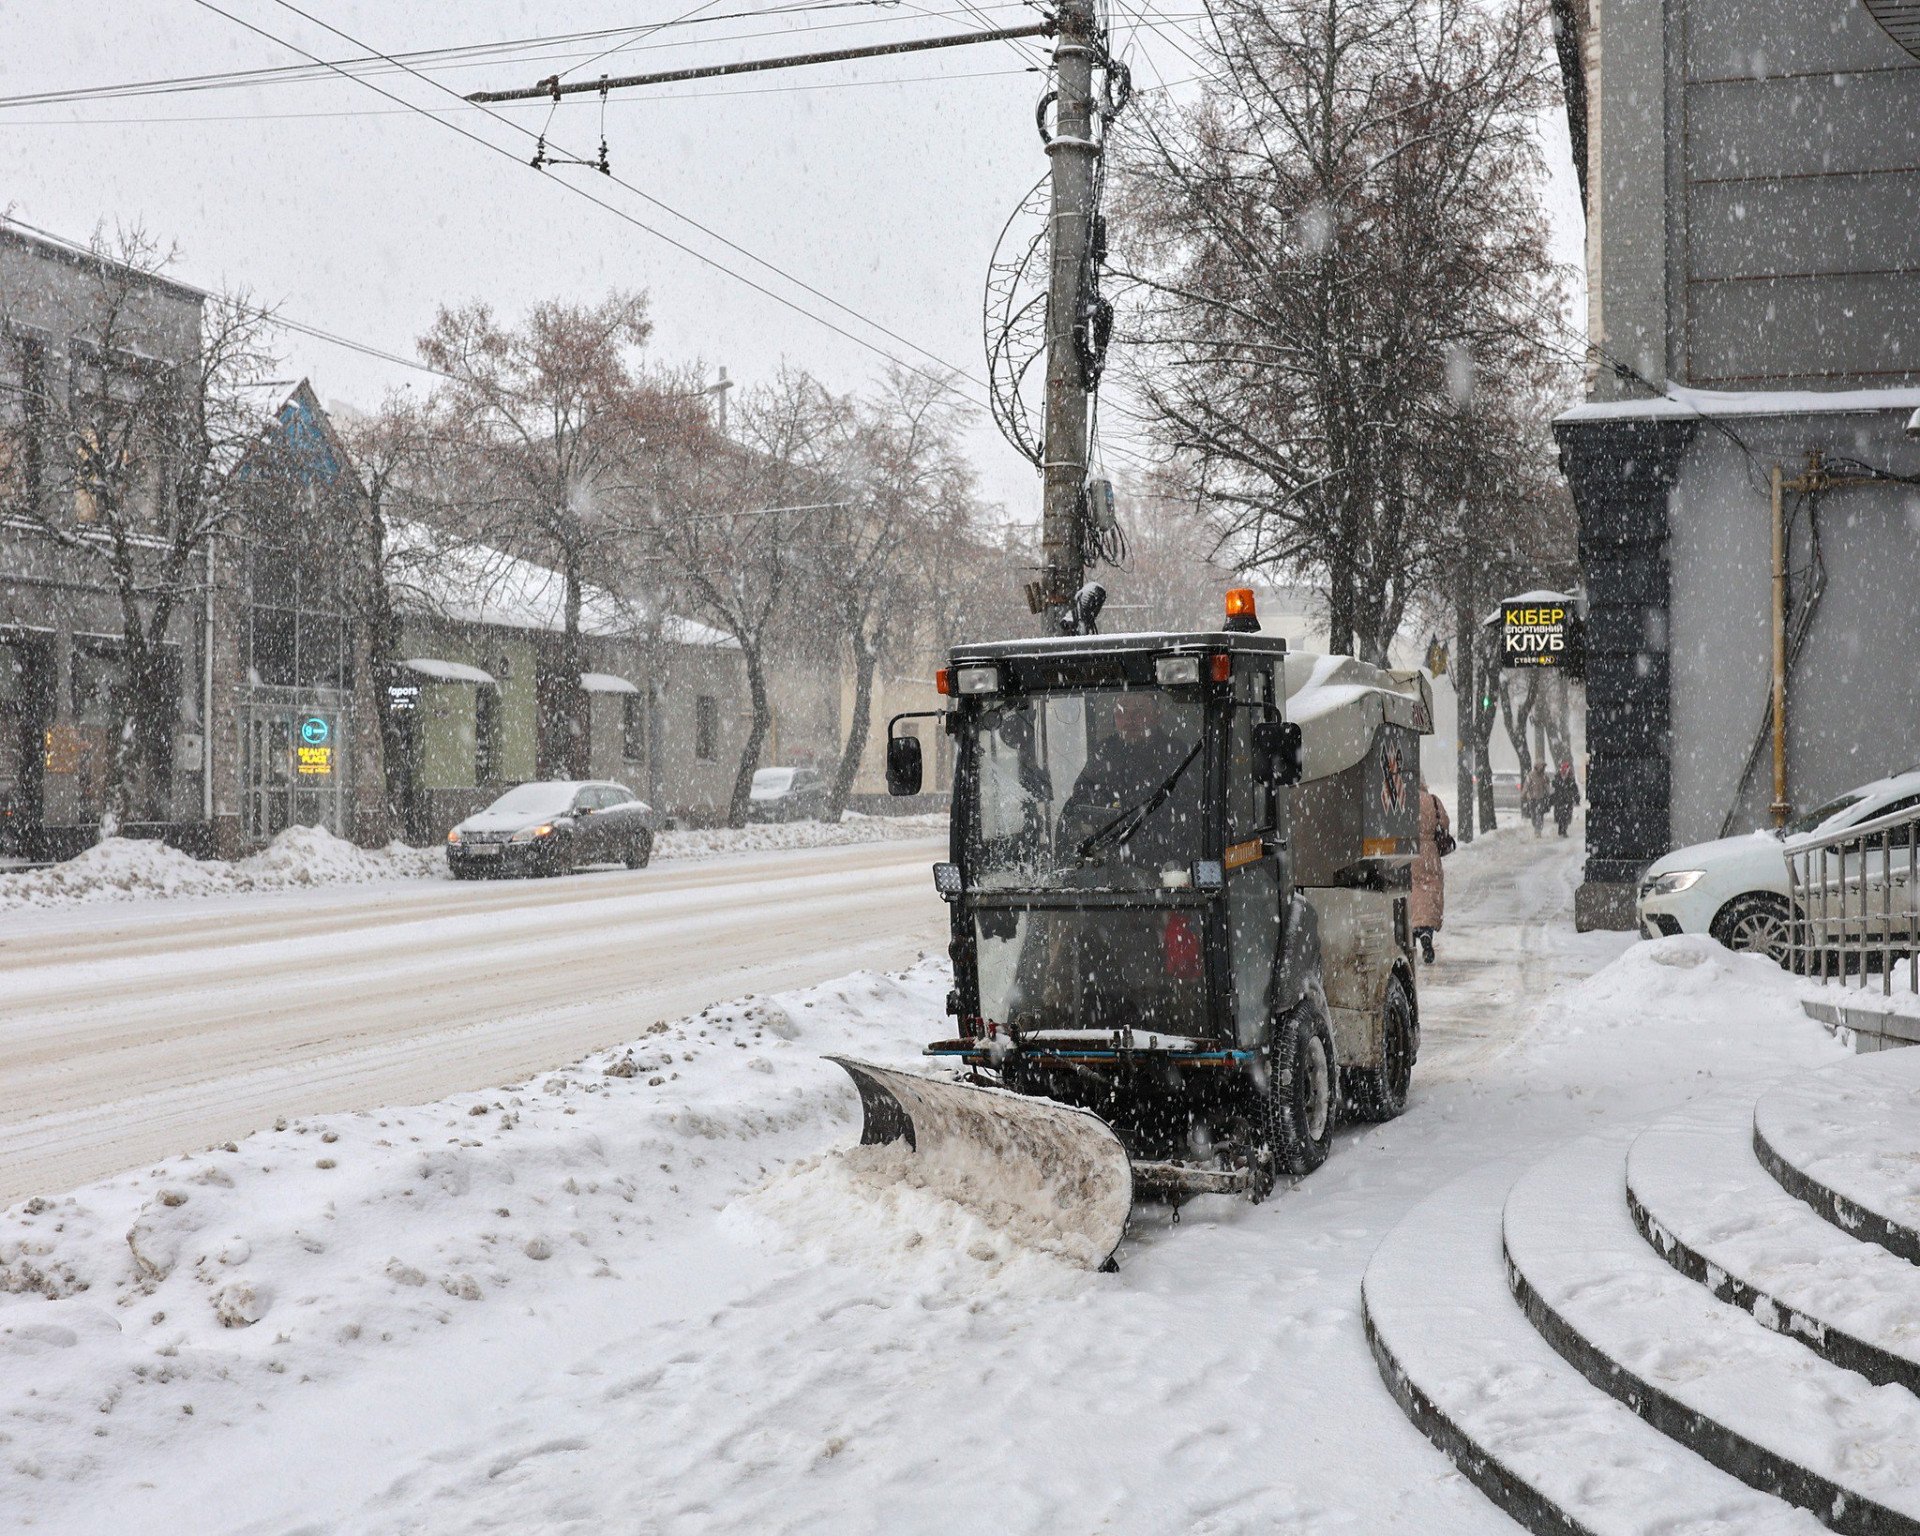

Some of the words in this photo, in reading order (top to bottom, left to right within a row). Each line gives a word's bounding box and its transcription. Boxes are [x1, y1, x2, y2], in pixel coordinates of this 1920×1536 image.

[1506, 609, 1564, 625] КІБЕР
[1505, 624, 1563, 634] СПОРТИВНИЙ
[1506, 633, 1565, 652] КЛУБ
[297, 747, 331, 757] BEAUTY
